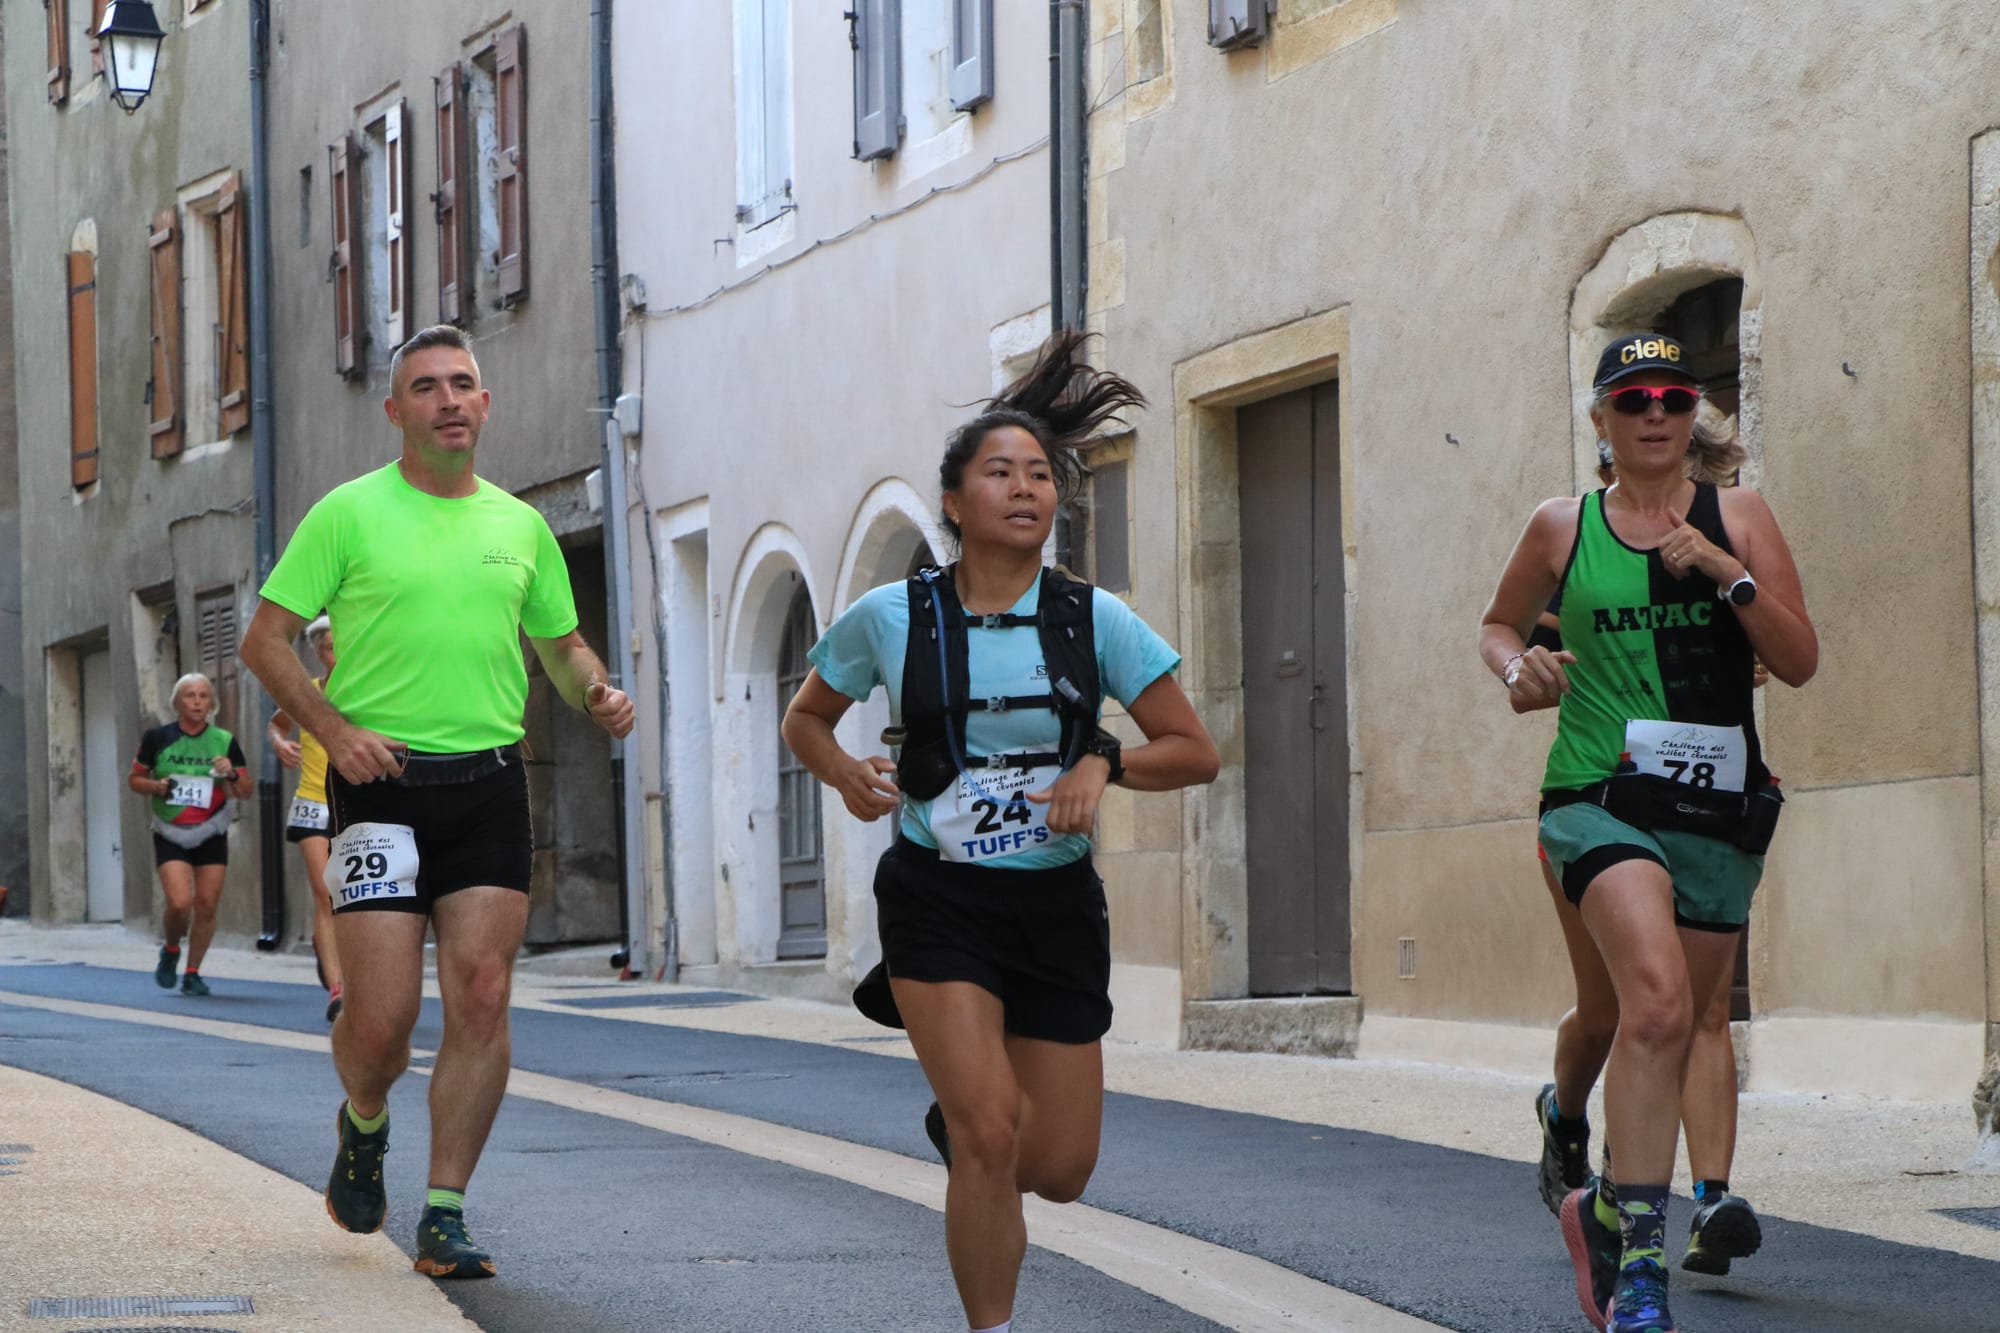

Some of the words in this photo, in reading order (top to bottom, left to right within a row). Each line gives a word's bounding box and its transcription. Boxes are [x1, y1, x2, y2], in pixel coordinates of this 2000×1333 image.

[1621, 339, 1680, 365] ciele
[1592, 602, 1712, 633] AATAC
[1661, 740, 1705, 753] Challenge
[1663, 760, 1715, 788] 78
[175, 787, 203, 799] 141
[294, 804, 320, 819] 135
[971, 790, 1032, 834] 24
[961, 826, 1049, 858] TUFF'S
[345, 852, 388, 884] 29
[340, 881, 399, 902] TUFF'S
